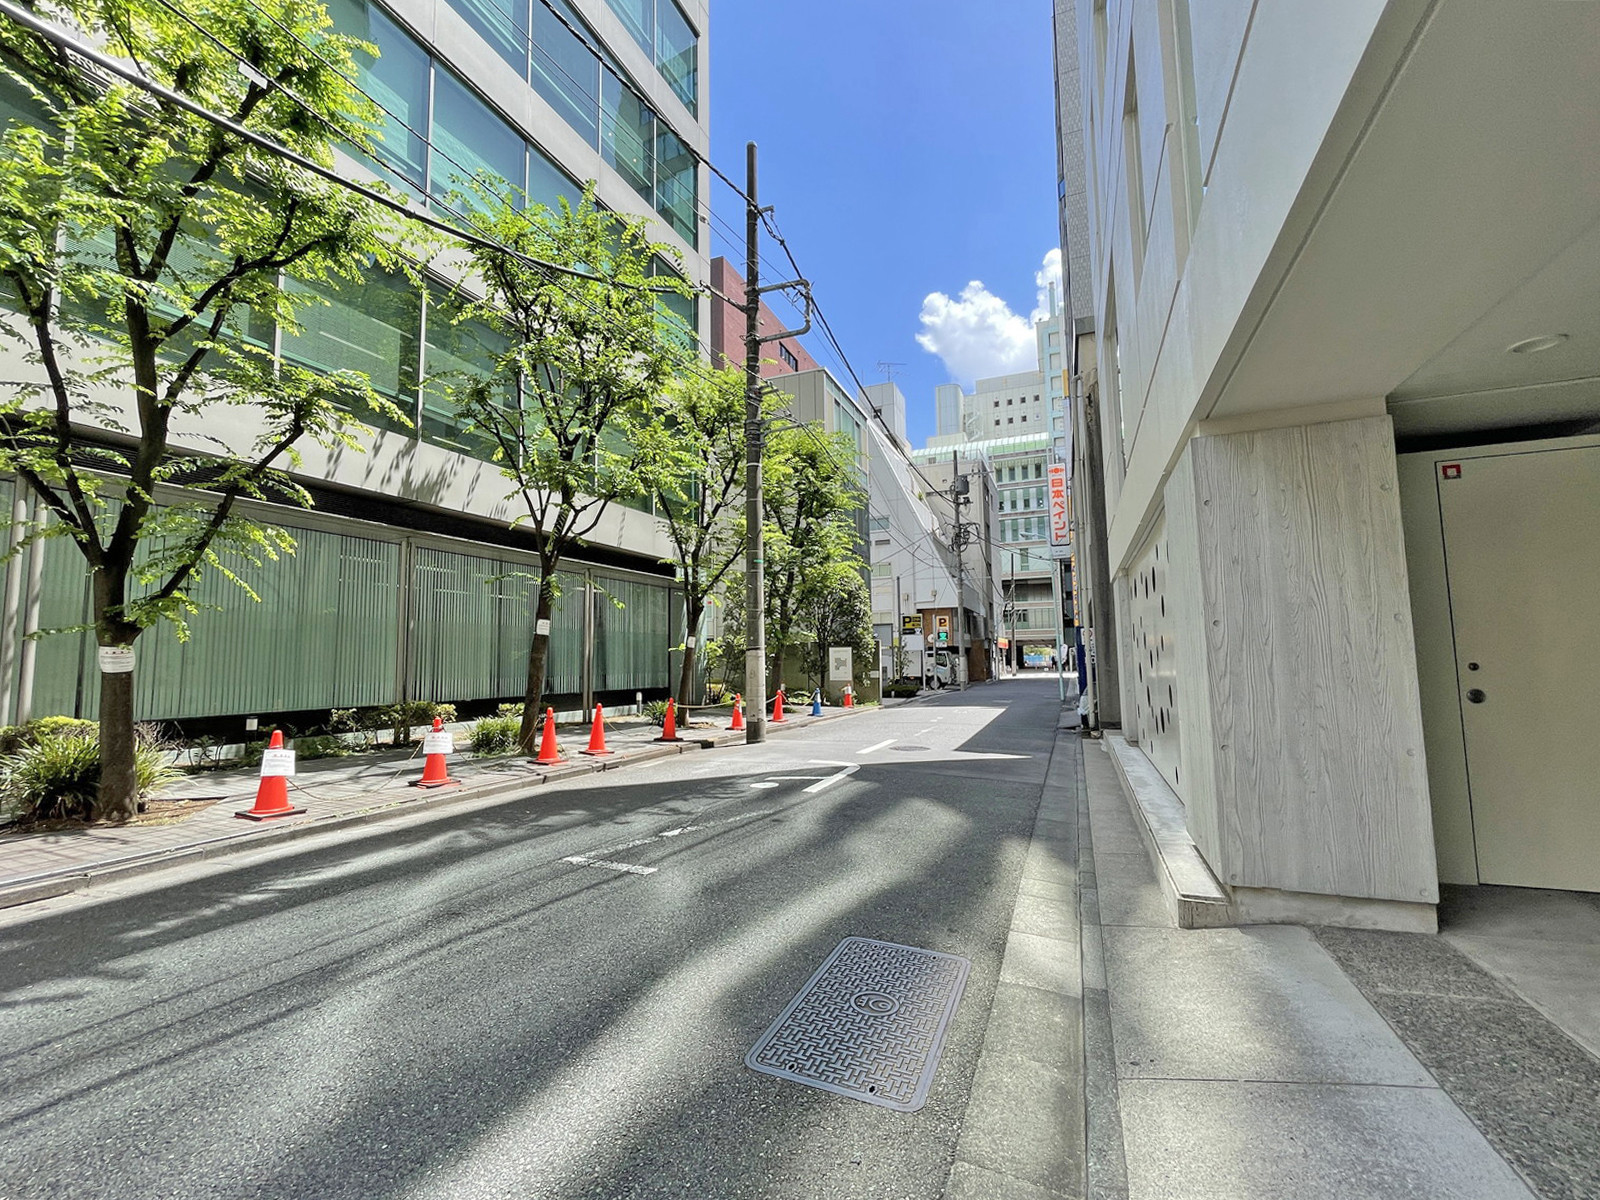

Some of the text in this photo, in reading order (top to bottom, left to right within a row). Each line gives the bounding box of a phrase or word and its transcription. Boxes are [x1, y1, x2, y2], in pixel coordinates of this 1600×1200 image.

[1051, 478, 1066, 541] 日本ペイント
[902, 616, 911, 627] P
[939, 618, 947, 627] P
